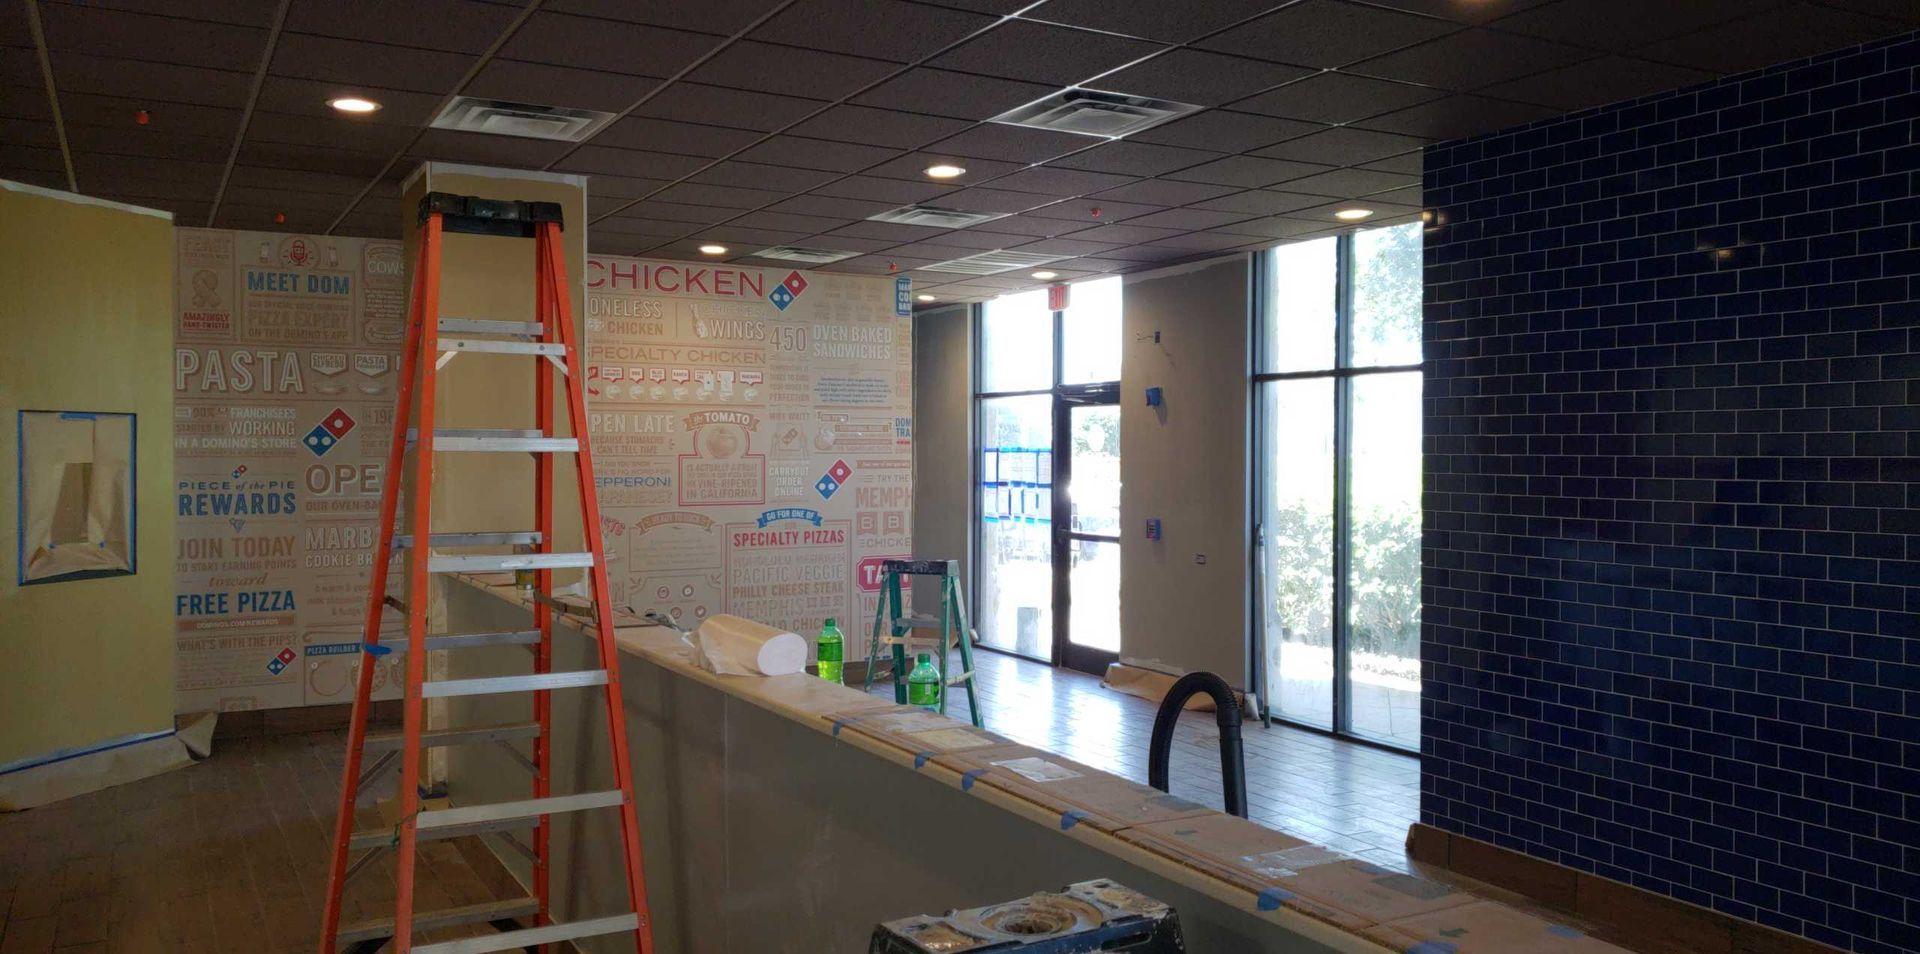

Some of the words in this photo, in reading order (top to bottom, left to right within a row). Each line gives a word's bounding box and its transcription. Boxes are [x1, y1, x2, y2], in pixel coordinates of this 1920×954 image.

[247, 271, 300, 292] MEET
[307, 274, 350, 295] DOM
[587, 260, 763, 297] CHICKEN
[590, 298, 663, 319] ONELESS
[183, 312, 230, 322] AMAZINGLY
[607, 321, 664, 336] CHICKEN
[710, 319, 766, 341] WINGS
[813, 324, 848, 342] OVEN
[851, 326, 892, 343] BAKED
[687, 349, 767, 364] CHICKEN
[814, 343, 891, 360] SANDWICHES
[356, 355, 385, 365] PASTA
[175, 350, 305, 394] PASTA
[230, 407, 296, 418] FRANCHISEES
[704, 412, 751, 425] TOMATO
[229, 421, 295, 436] WORKING
[591, 414, 626, 433] PEN
[634, 414, 675, 433] LATE
[175, 438, 188, 449] IN
[191, 438, 199, 449] A
[202, 438, 258, 449] DOMINO'S
[261, 438, 297, 449] STORE
[640, 446, 658, 454] TIME
[769, 466, 809, 477] CARRYOUT
[877, 474, 892, 483] TRY
[894, 474, 910, 483] THE
[179, 481, 231, 491] PIECE
[235, 480, 246, 491] of
[248, 481, 266, 490] the
[269, 481, 295, 490] PIE
[595, 476, 672, 488] EPPERONI
[776, 477, 801, 486] ORDER
[687, 489, 697, 499] IN
[700, 489, 758, 499] CALIFORNIA
[775, 487, 804, 497] ONLINE
[179, 493, 296, 516] REWARDS
[305, 501, 328, 511] OUR
[766, 512, 777, 521] GO
[779, 511, 791, 519] FOR
[792, 510, 804, 518] ONE
[805, 510, 815, 519] OF
[733, 531, 800, 547] SPECIALTY
[803, 530, 845, 545] PIZZAS
[866, 536, 912, 548] CHICKE
[177, 537, 223, 560] JOIN
[231, 535, 296, 558] TODAY
[191, 561, 219, 572] START
[222, 560, 263, 571] EARNING
[265, 559, 297, 569] POINTS
[305, 554, 352, 568] COOKIE
[208, 573, 268, 588] toward
[733, 566, 790, 584] PACIFIC
[796, 563, 843, 582] VEGGIE
[732, 586, 768, 600] PHILLY
[771, 583, 810, 597] CHEESE
[814, 582, 844, 596] STEAK
[176, 593, 229, 616] FREE
[238, 590, 296, 613] PIZZA
[792, 616, 845, 632] CHICN
[176, 638, 216, 651] WHAT'S
[217, 637, 244, 650] WITH
[245, 635, 265, 649] THE
[267, 634, 298, 647] PIPS?
[307, 647, 328, 656] PIZZA
[328, 646, 356, 655] BUILDER
